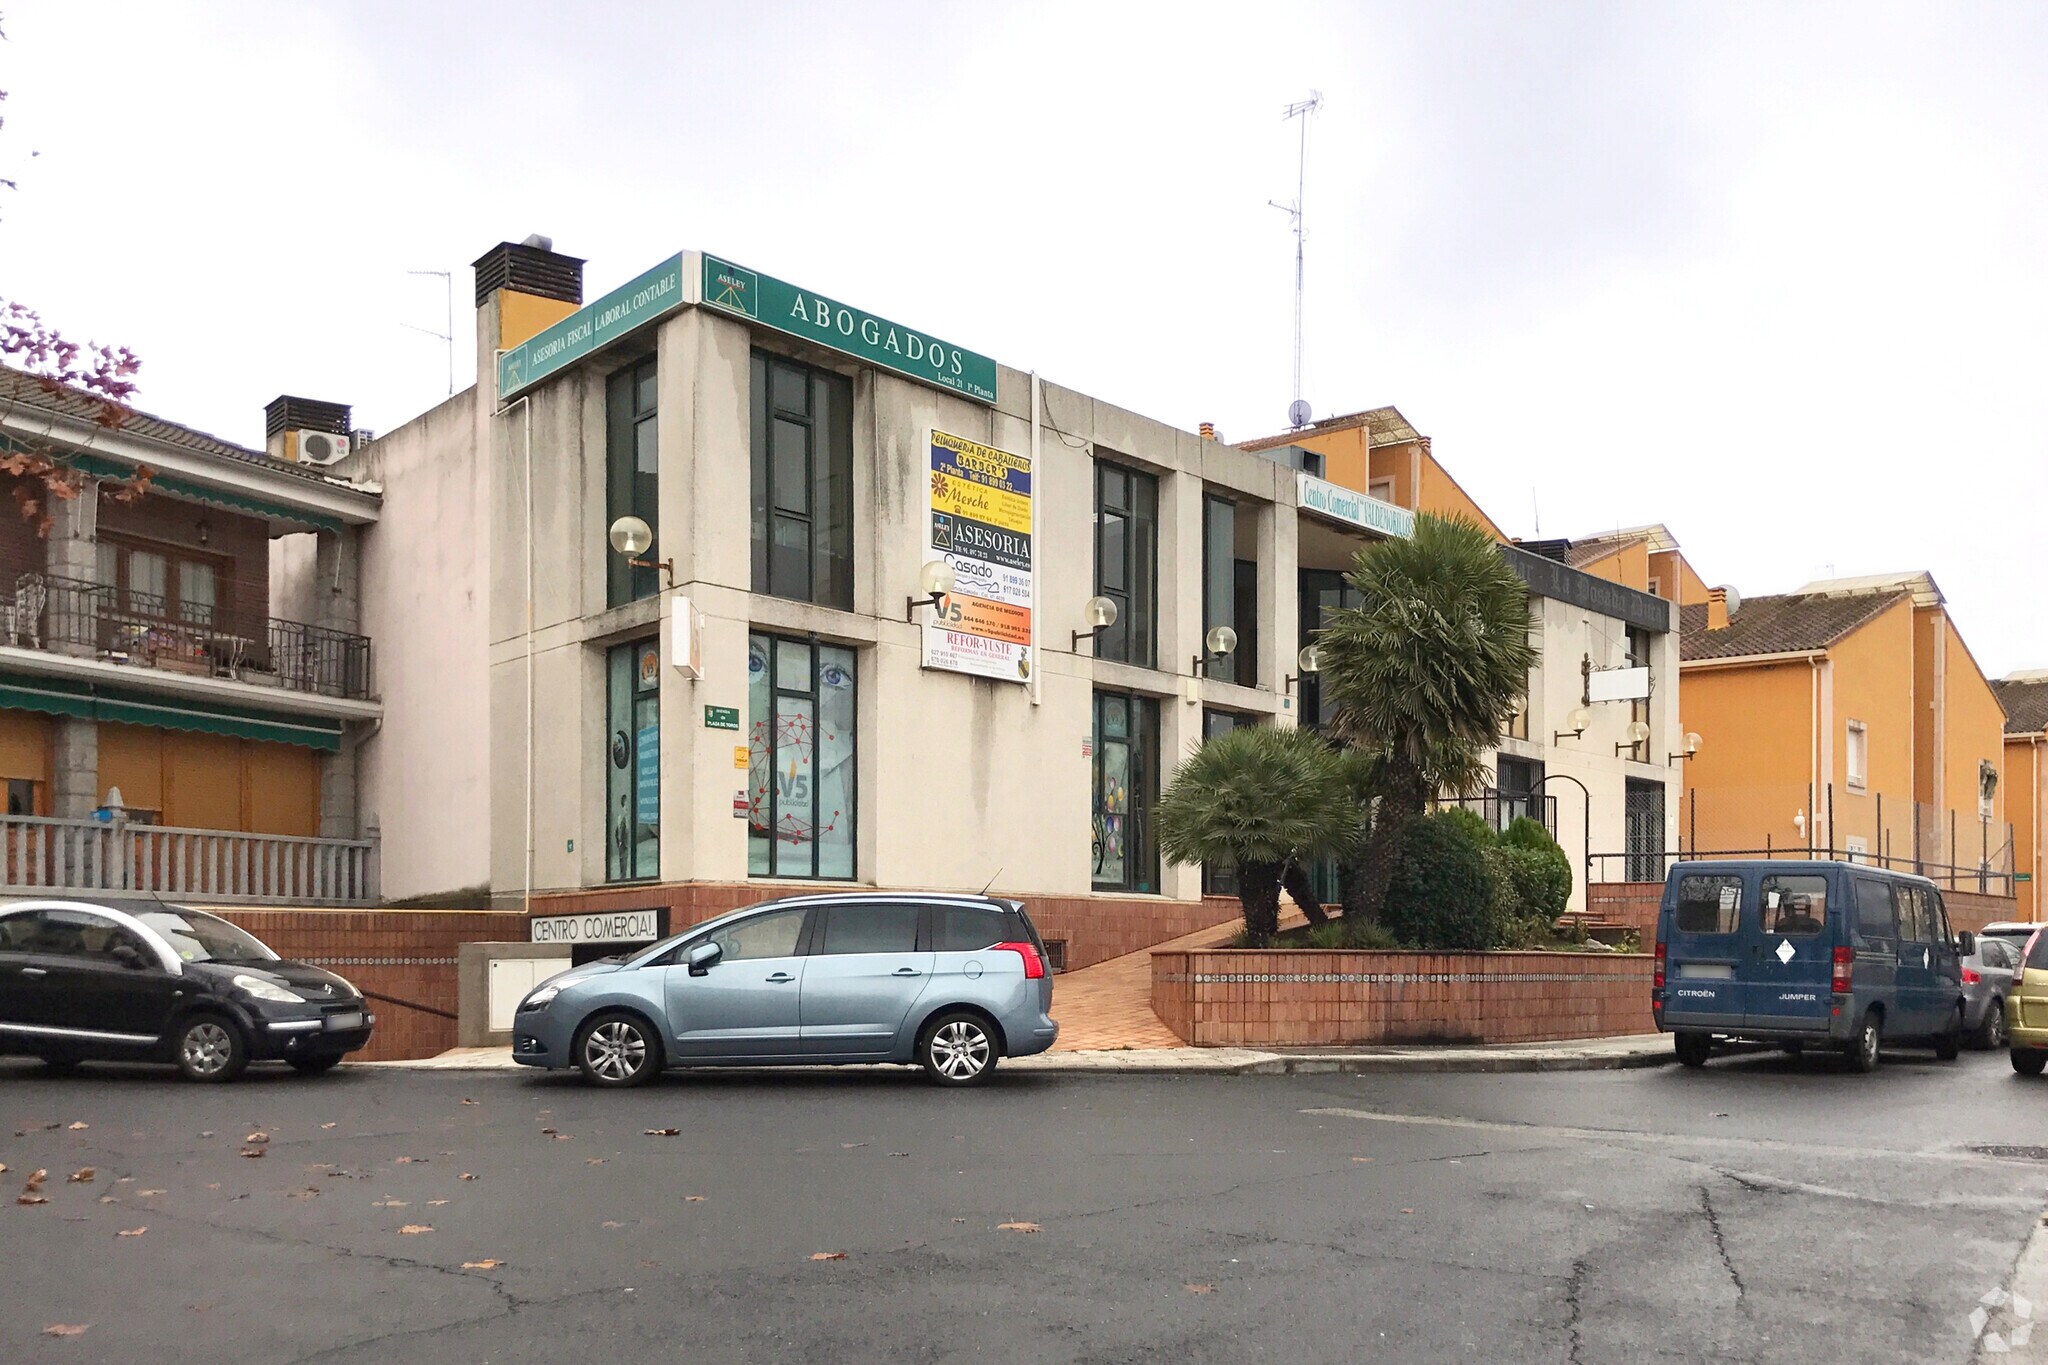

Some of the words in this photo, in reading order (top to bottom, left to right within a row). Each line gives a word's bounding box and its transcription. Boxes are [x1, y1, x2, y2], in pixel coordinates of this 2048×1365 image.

[717, 273, 746, 289] ASELEY
[531, 339, 566, 367] ASESORIA
[567, 320, 593, 346] FISCAL
[594, 305, 632, 332] LABORAL
[632, 273, 676, 311] CONTABLE
[790, 293, 962, 374] ABOGADOS
[938, 371, 955, 386] Local
[974, 384, 994, 400] Planta
[976, 446, 987, 457] DE
[958, 453, 1006, 478] BARBER'S
[945, 487, 989, 511] Merche
[1304, 480, 1326, 511] Centro
[1327, 488, 1359, 522] Comercial
[954, 523, 1030, 559] ASESORIA
[944, 553, 993, 579] Casado
[936, 596, 962, 622] V5
[971, 601, 995, 610] AGENCIA
[1004, 608, 1024, 617] MEDIOS
[946, 632, 1012, 654] REFOR-YUSTE
[777, 765, 808, 799] V5
[534, 918, 578, 941] CENTRO
[1677, 989, 1715, 998] CITROËN
[1779, 993, 1816, 1001] JUMPER
